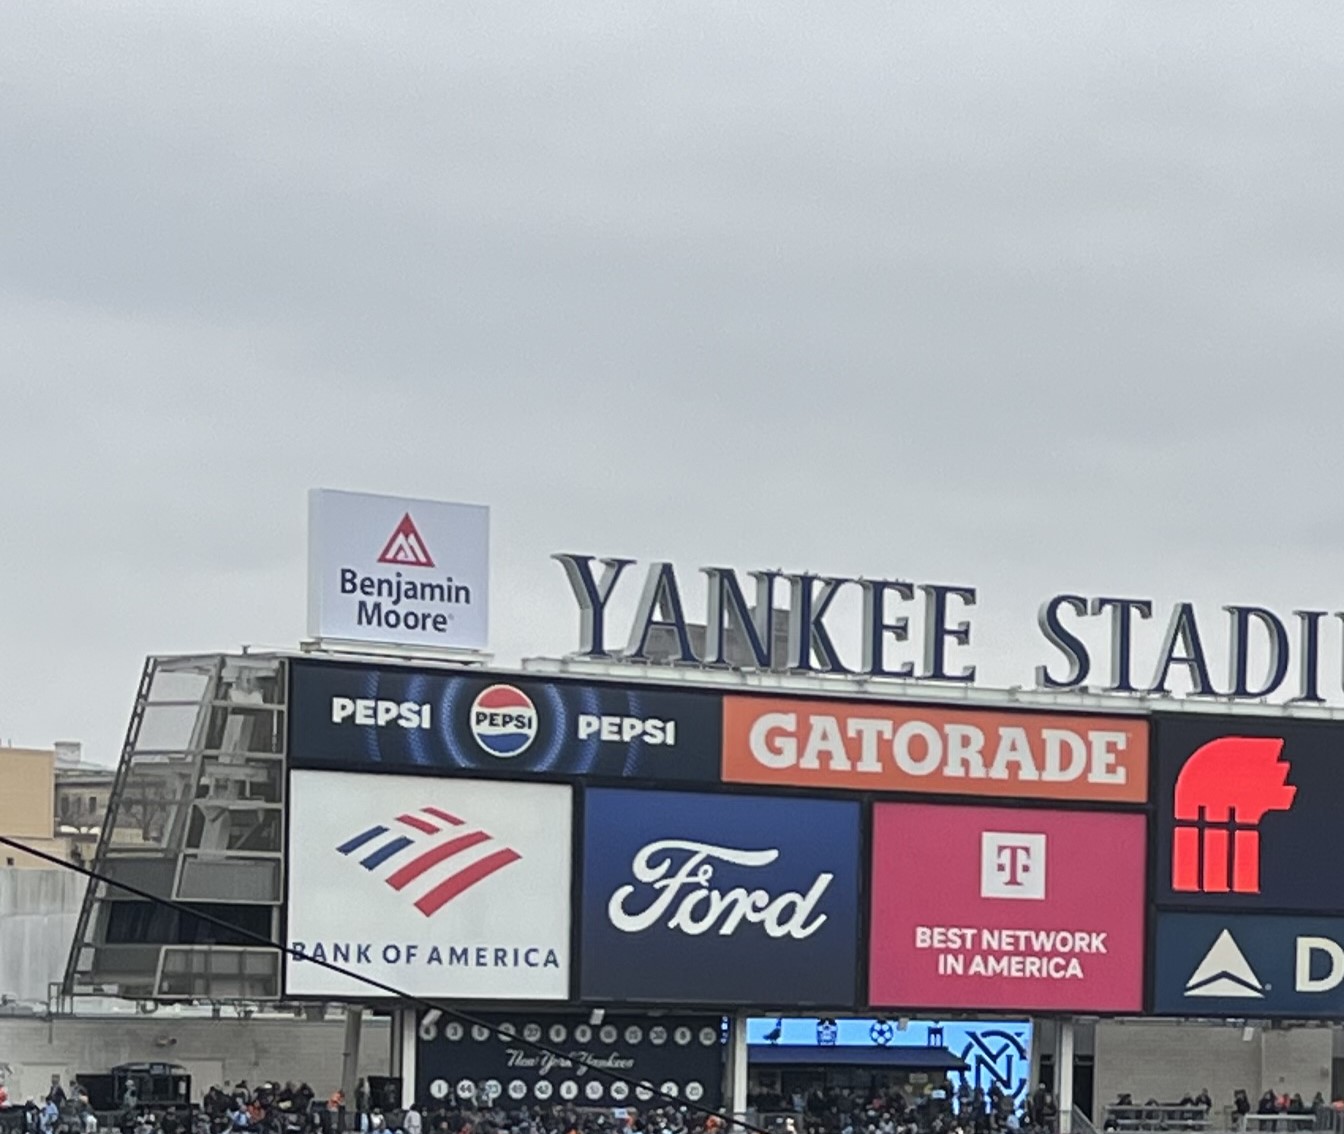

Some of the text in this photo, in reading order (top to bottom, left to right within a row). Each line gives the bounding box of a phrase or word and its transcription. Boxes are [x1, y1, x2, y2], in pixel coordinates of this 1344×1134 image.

[340, 568, 471, 605] Benjamin
[356, 601, 448, 633] Moore
[552, 553, 976, 683] YANKEE
[331, 696, 431, 729] PEPSI
[475, 707, 533, 732] PEPSI
[577, 713, 676, 745] PEPSI
[749, 711, 1128, 784] GATORADE
[607, 838, 835, 939] Ford
[291, 940, 561, 969] BANK OF AMERICA
[915, 926, 1108, 954] BEST NETWORK
[938, 953, 1084, 979] IN AMERICA
